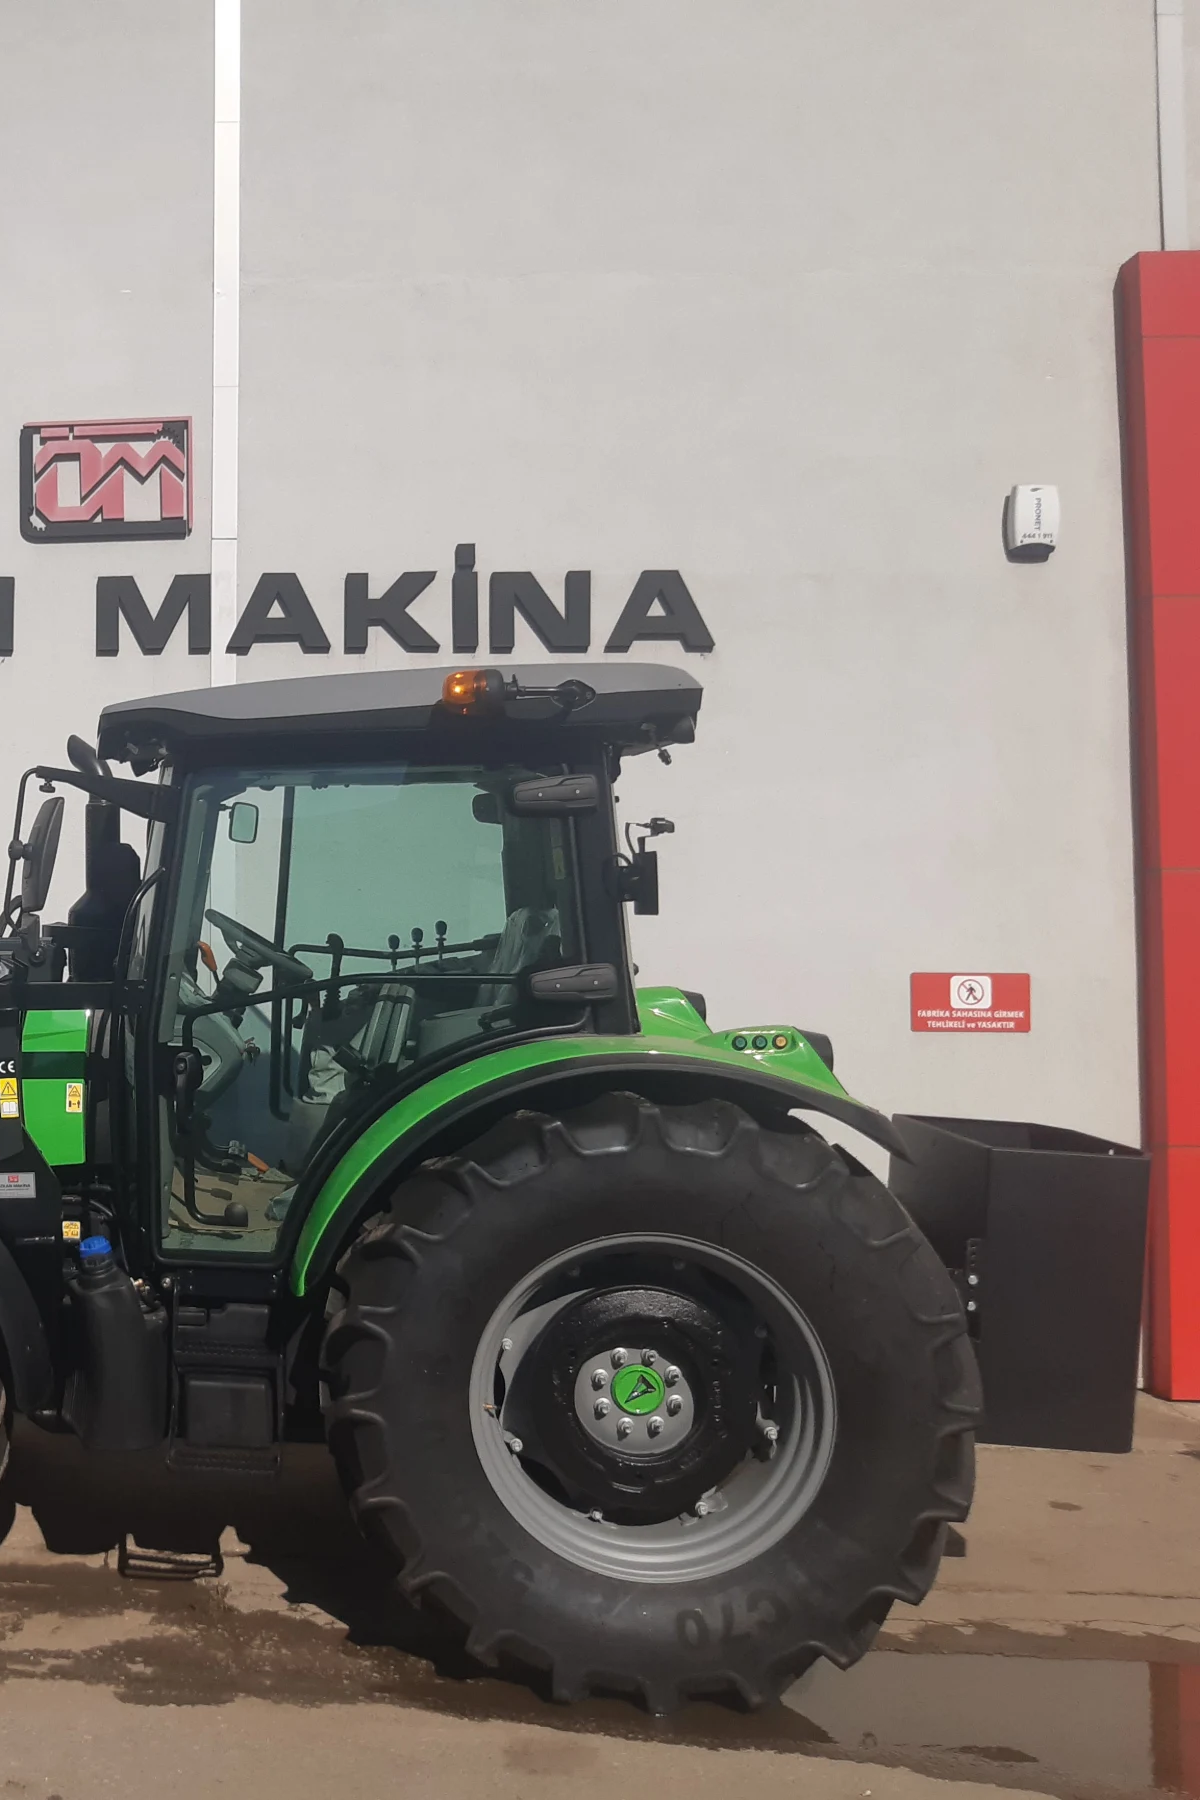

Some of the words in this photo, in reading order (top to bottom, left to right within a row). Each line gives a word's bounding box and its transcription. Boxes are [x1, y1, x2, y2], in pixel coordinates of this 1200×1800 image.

[1034, 497, 1042, 531] PRONET
[96, 543, 715, 657] MAKİNA
[917, 1009, 950, 1018] FABRİKA
[952, 1010, 992, 1018] SAHASINA
[993, 1010, 1024, 1018] GİRMEK
[927, 1020, 965, 1028] TEHLİKELİ
[977, 1021, 1015, 1029] YASAKTIR
